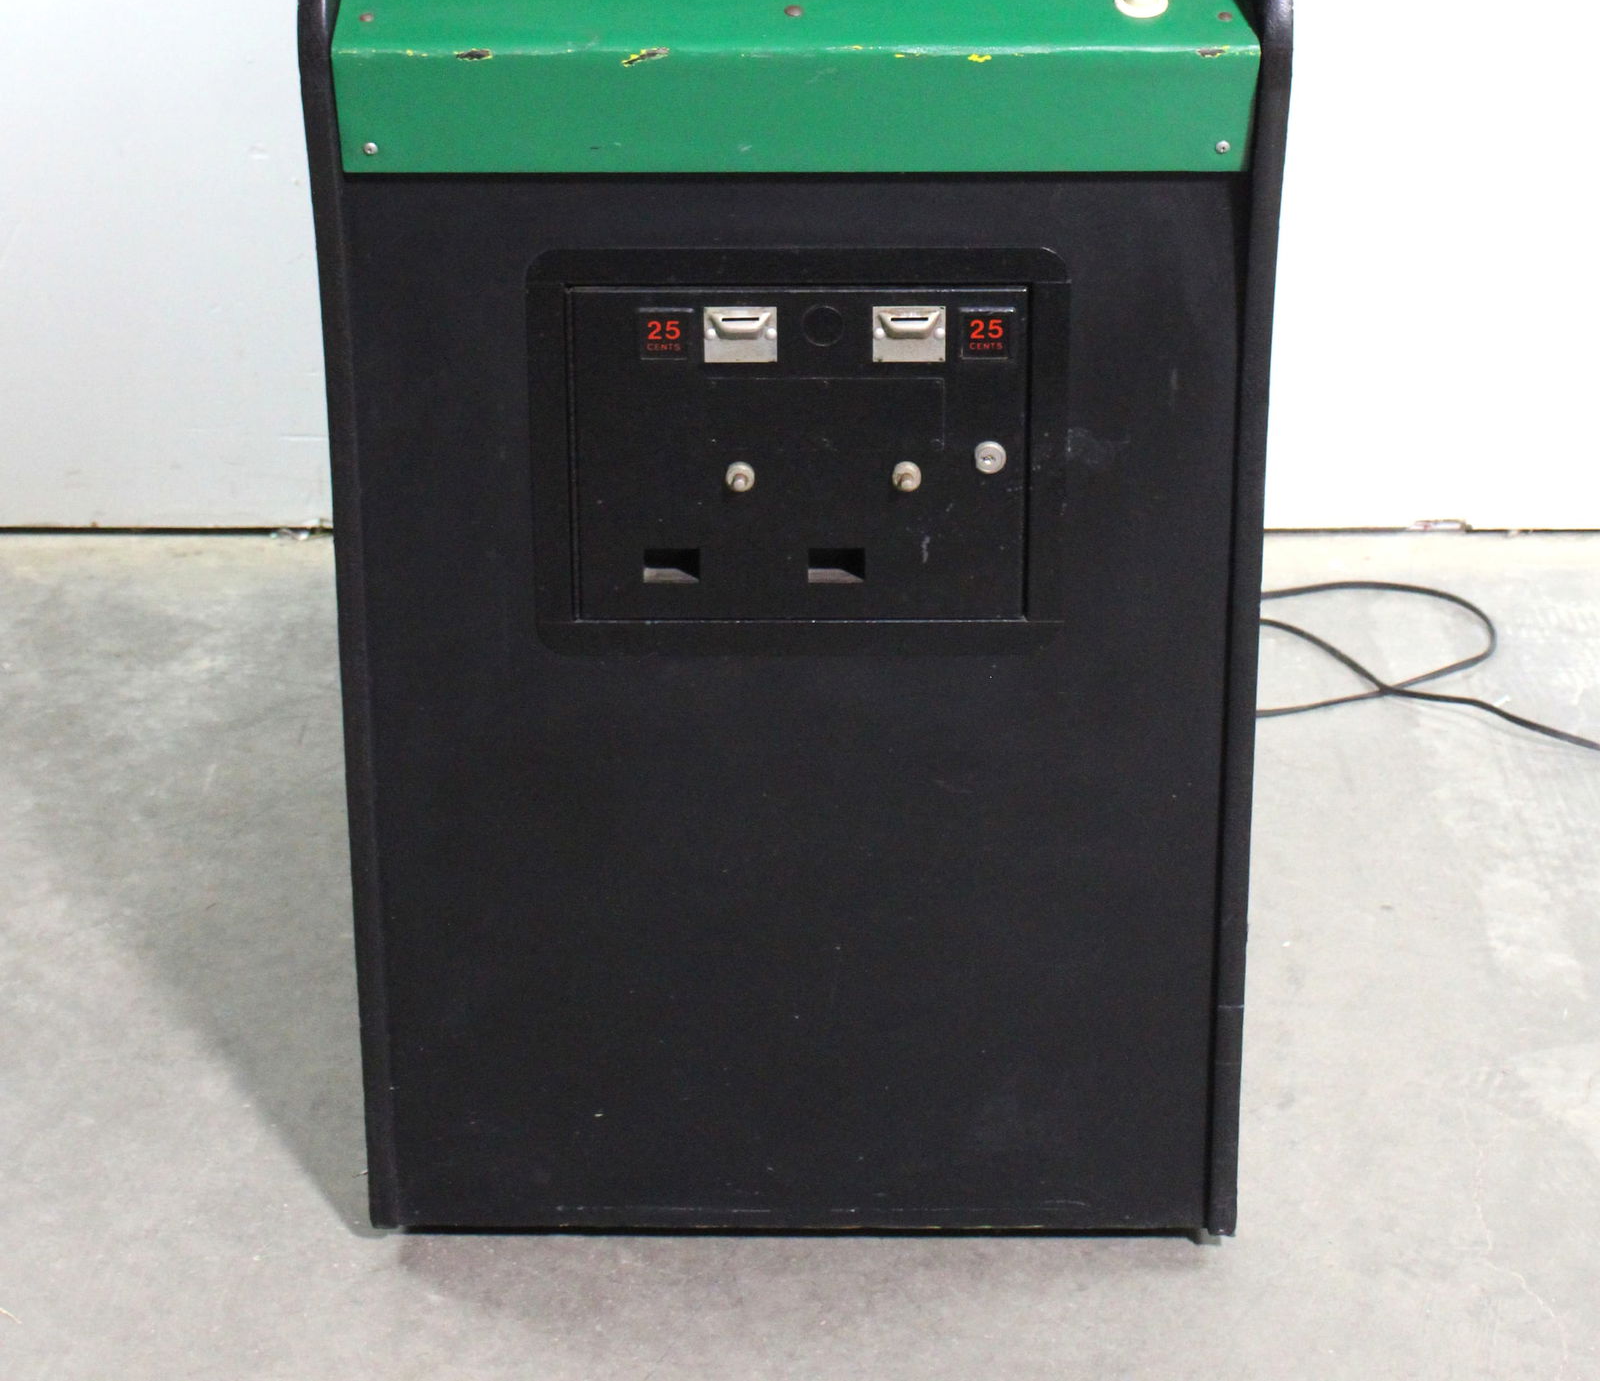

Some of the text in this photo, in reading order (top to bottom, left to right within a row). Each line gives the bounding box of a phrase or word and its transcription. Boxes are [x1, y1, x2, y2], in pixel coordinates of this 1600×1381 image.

[647, 320, 681, 340] 25
[970, 319, 1004, 339] 25
[646, 343, 681, 351] CENTS
[969, 342, 1003, 350] CENTS
